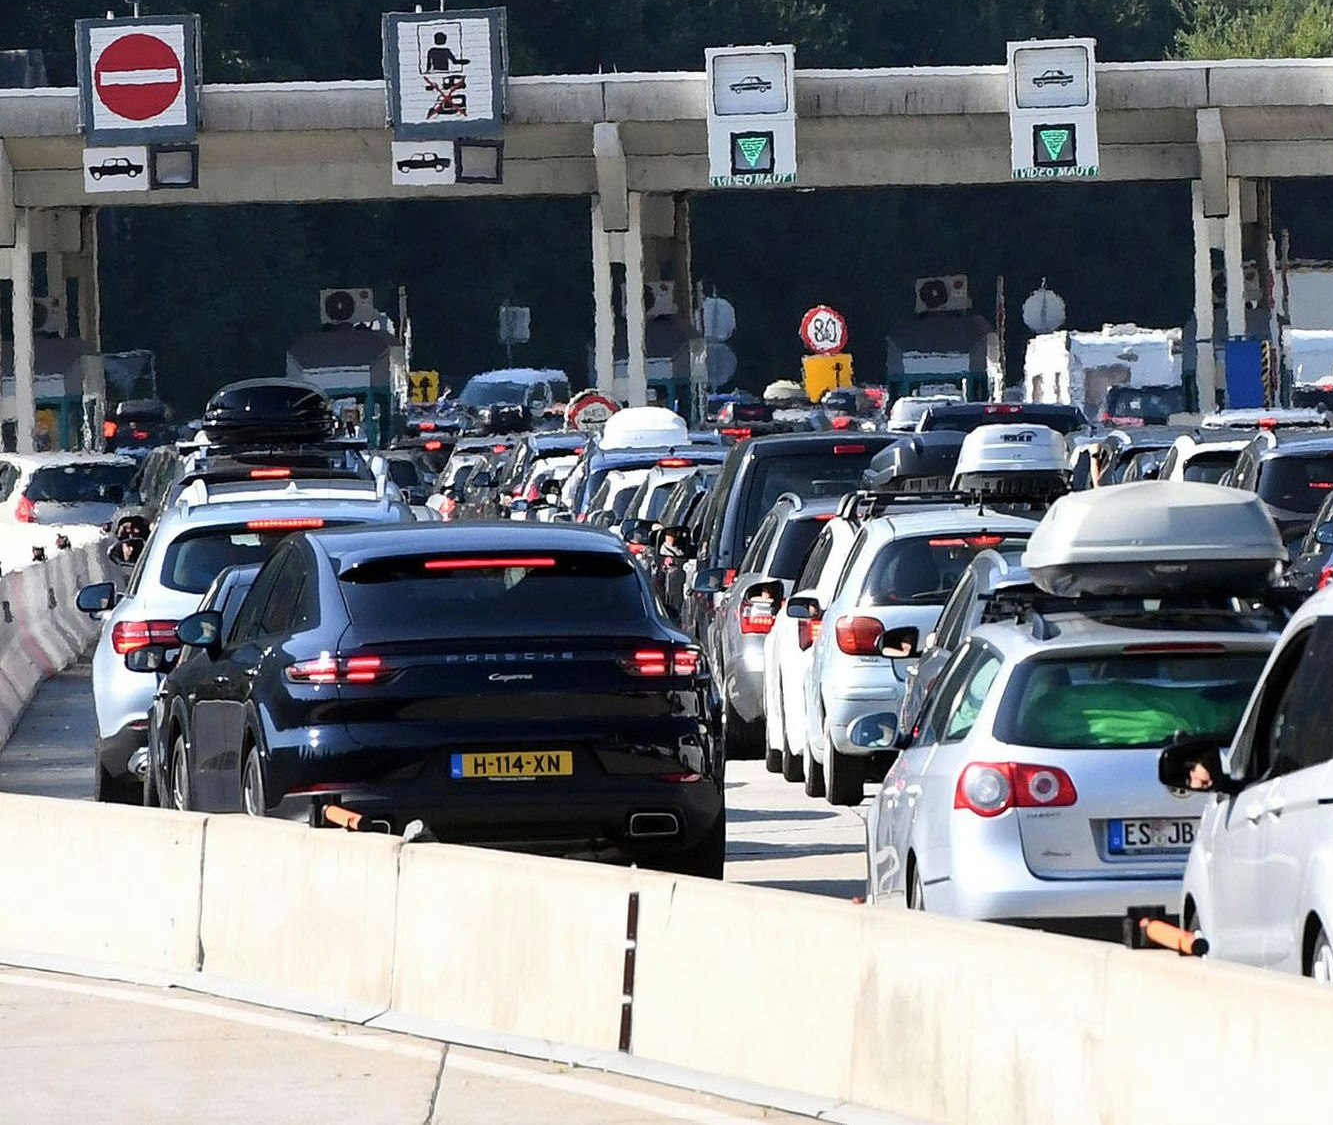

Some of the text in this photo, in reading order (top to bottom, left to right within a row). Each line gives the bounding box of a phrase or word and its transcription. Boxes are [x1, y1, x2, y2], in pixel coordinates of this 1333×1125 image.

[1020, 165, 1092, 178] VIDEO MAUT
[717, 173, 790, 186] VIDEO MAUT
[447, 652, 573, 663] PORSCHE
[474, 755, 560, 774] H-114-XN
[1125, 823, 1150, 845] ES
[1168, 822, 1194, 844] JB
